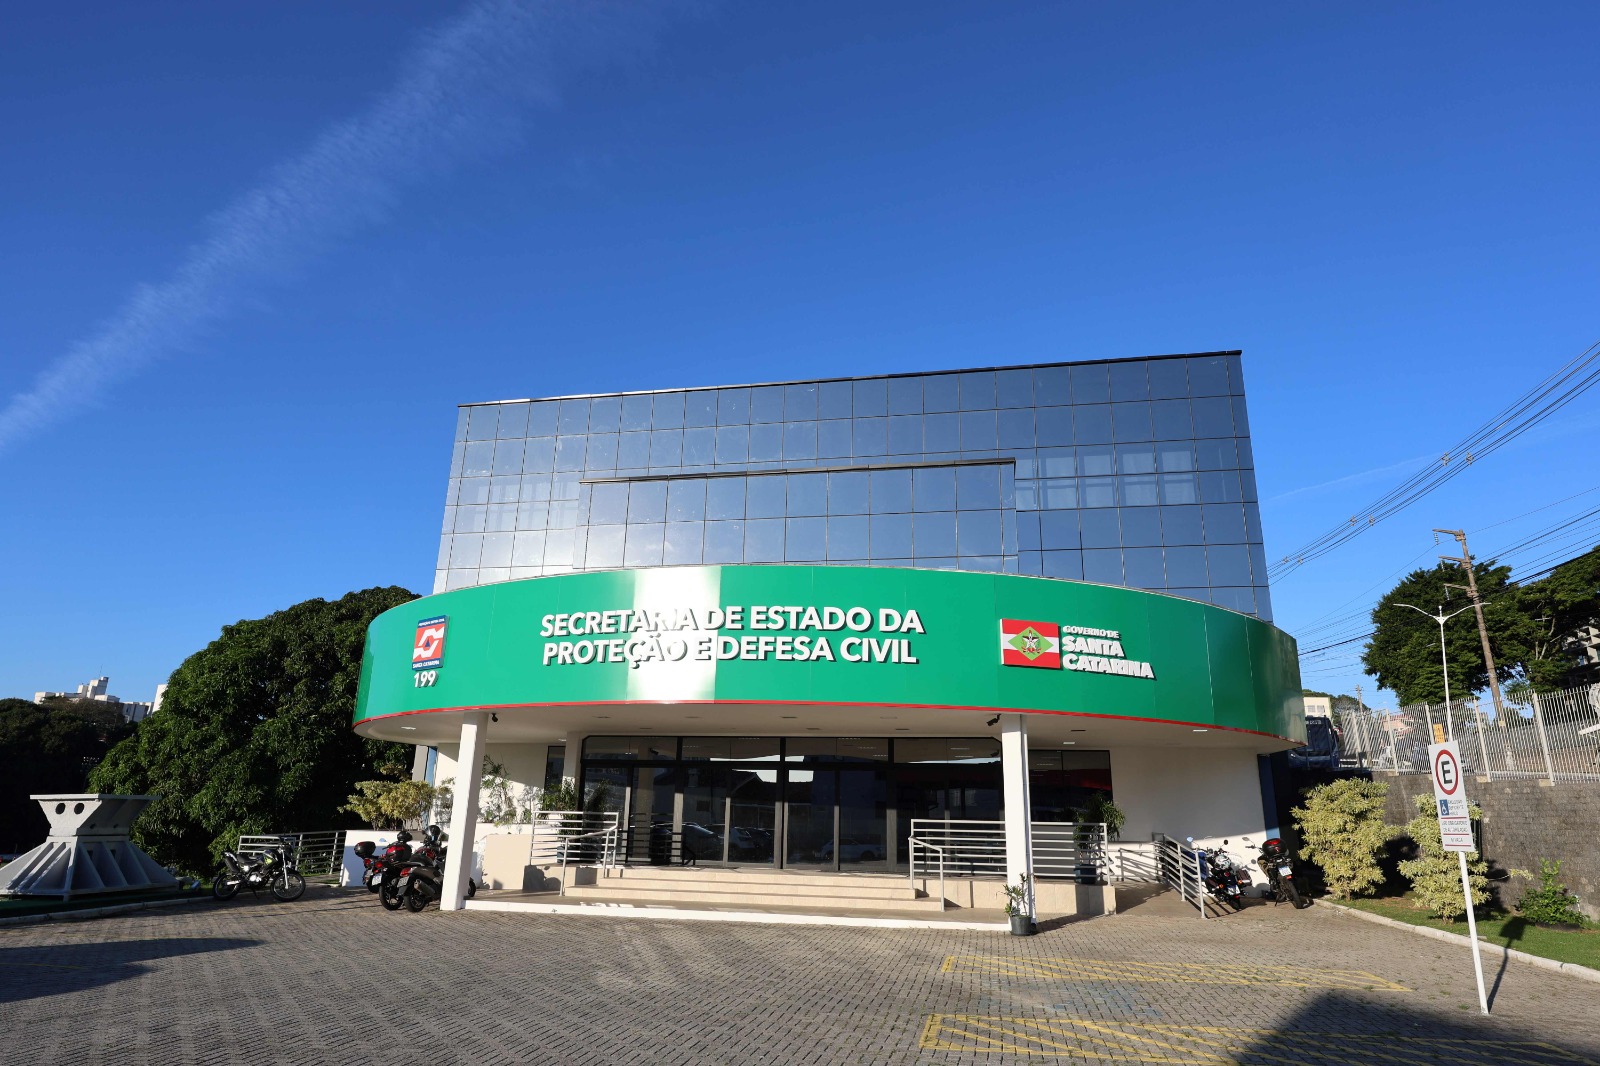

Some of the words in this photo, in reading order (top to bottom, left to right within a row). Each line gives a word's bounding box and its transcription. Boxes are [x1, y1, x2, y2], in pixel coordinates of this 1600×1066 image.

[540, 608, 699, 637] SECRETARIA
[704, 606, 745, 631] DE
[749, 605, 873, 632] ESTADO
[878, 609, 926, 634] DA
[1062, 625, 1106, 637] GOVERNO
[1107, 630, 1120, 639] DE
[542, 632, 689, 669] PROTEÇÃO
[694, 636, 712, 661] E
[717, 636, 835, 663] DEFESA
[840, 636, 920, 665] CIVIL
[1062, 635, 1125, 658] SANTA
[1062, 653, 1155, 679] CATARINA
[413, 670, 437, 688] 199
[1441, 760, 1453, 784] E
